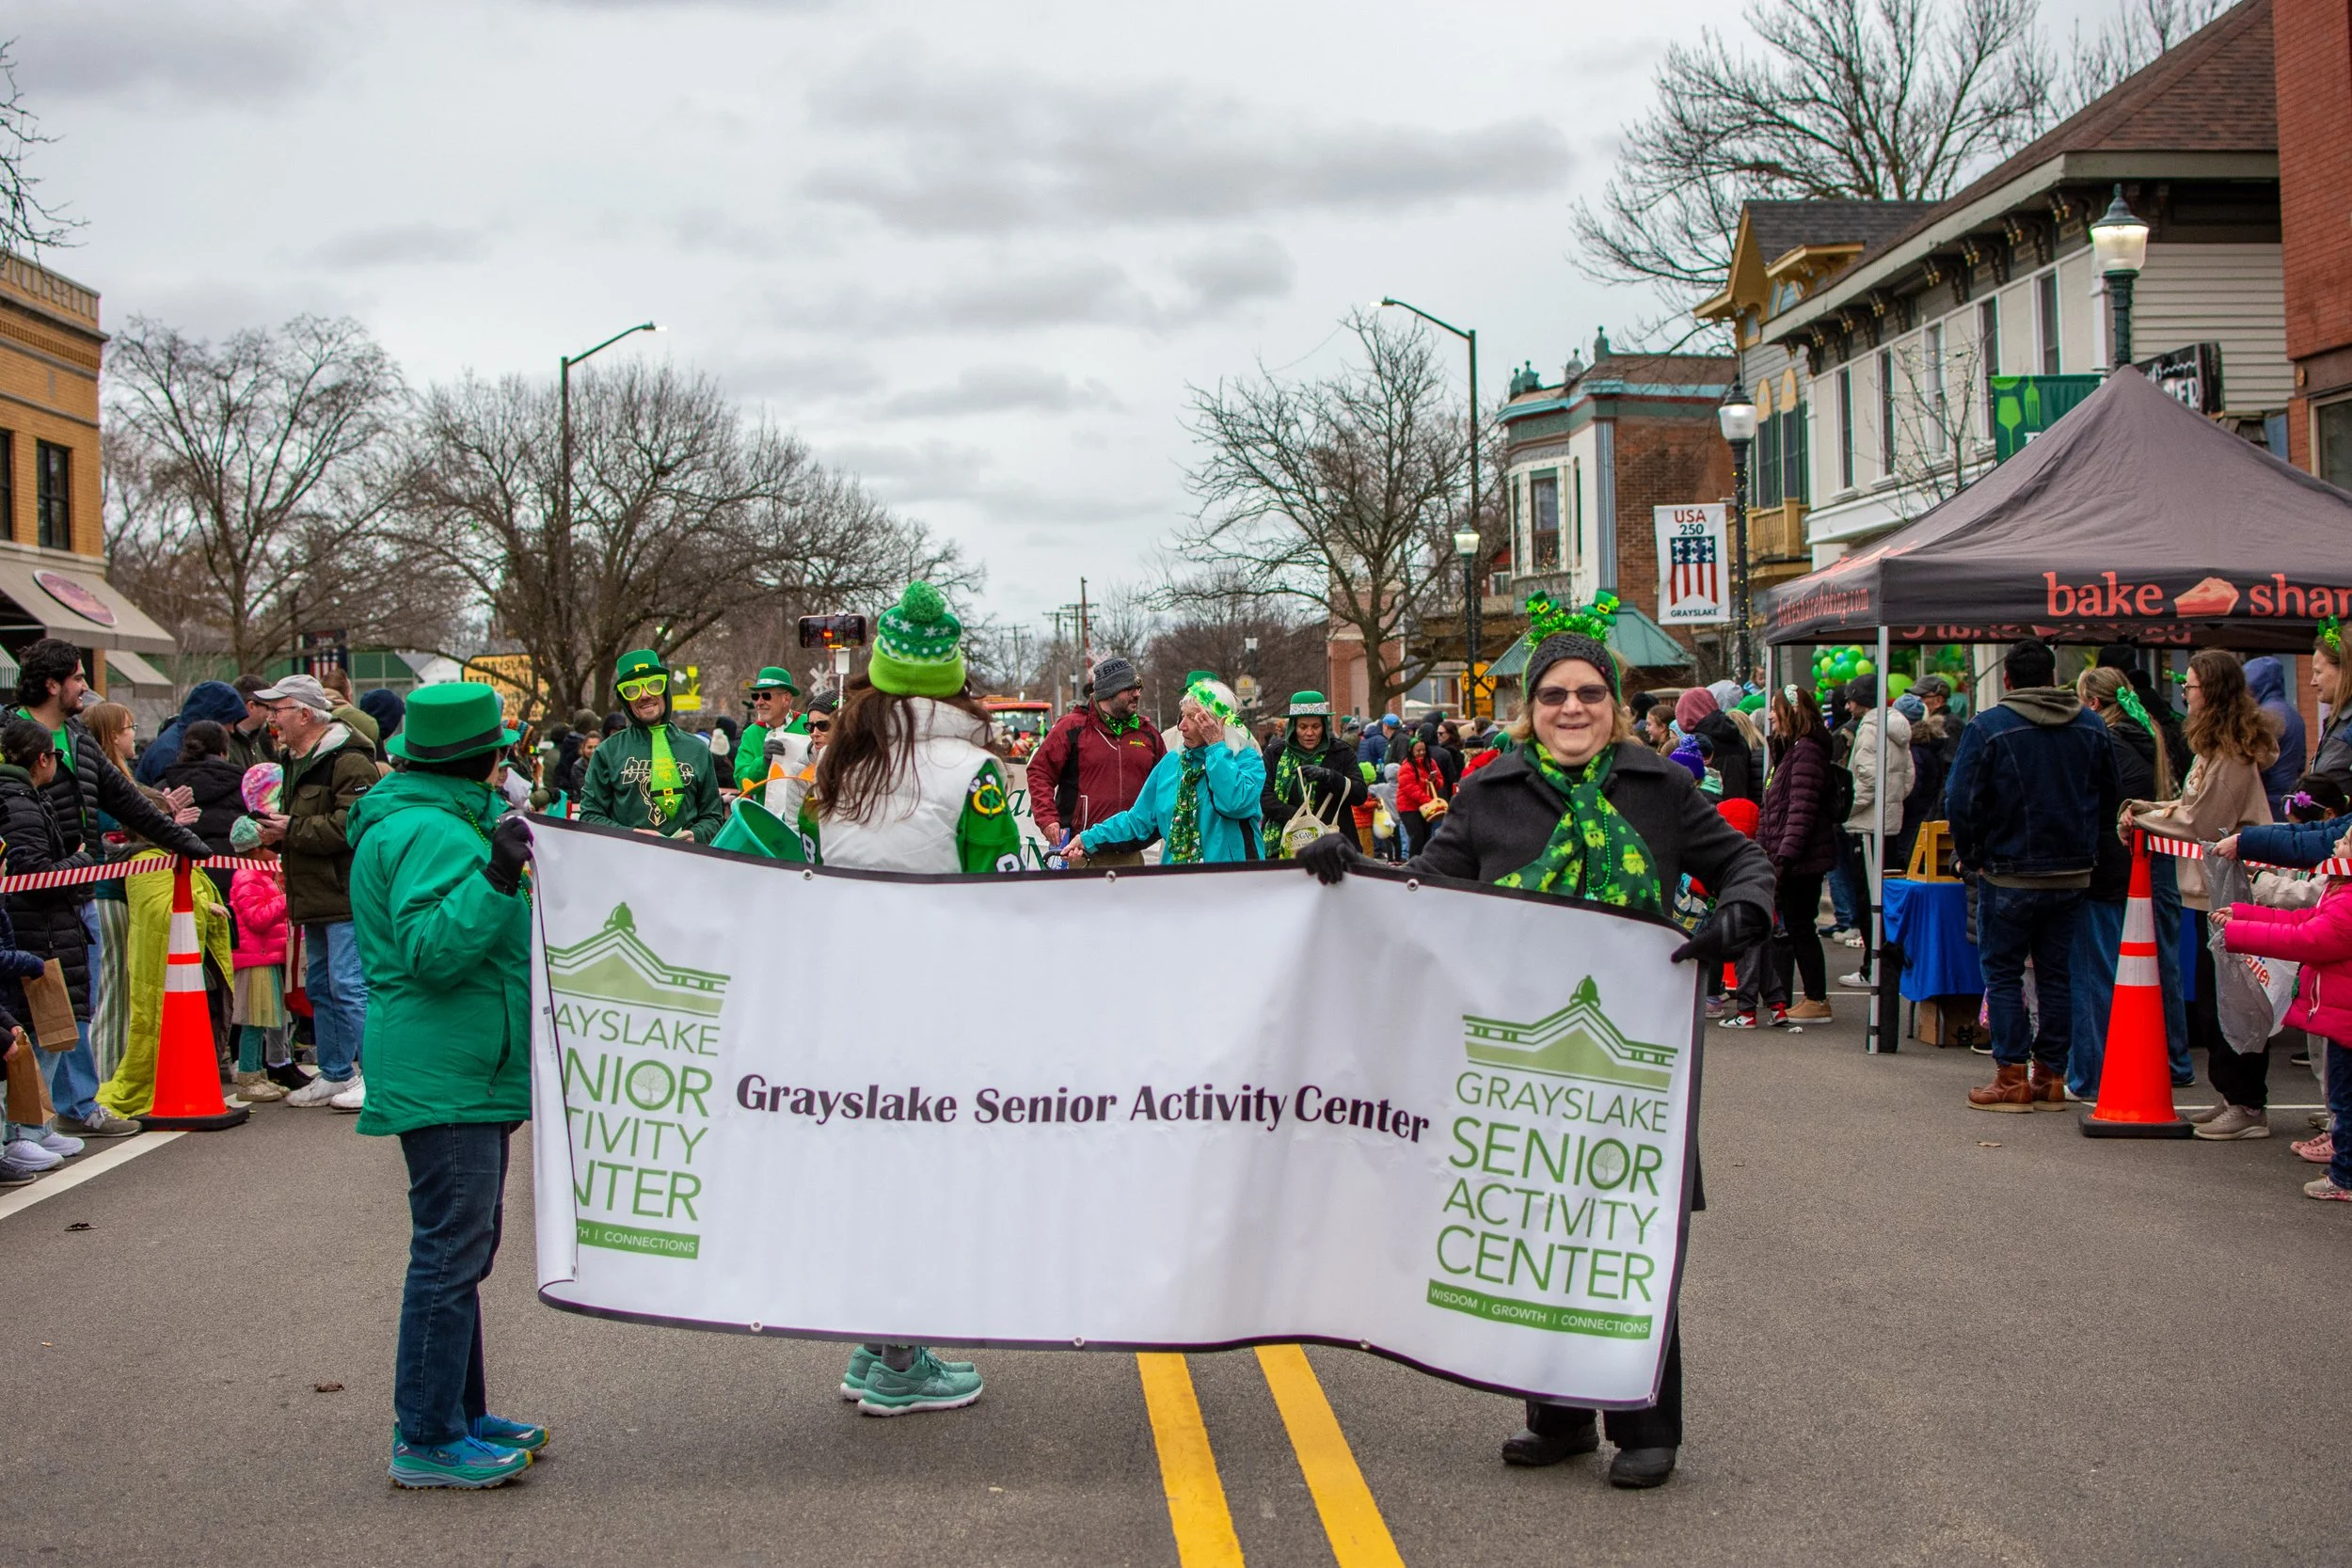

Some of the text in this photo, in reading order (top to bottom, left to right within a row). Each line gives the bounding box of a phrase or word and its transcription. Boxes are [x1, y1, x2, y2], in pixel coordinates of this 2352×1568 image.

[1675, 509, 1707, 523] USA
[1679, 523, 1705, 535] 250
[1670, 608, 1718, 618] GRAYSLAKE
[1777, 581, 1869, 628] bakesharebaking.com
[2042, 571, 2164, 617] bake
[737, 1073, 1430, 1143] Grayslake Senior Activity Center
[1456, 1071, 1669, 1133] GRAYSLAKE
[1449, 1116, 1663, 1196] SENIOR
[1442, 1177, 1660, 1245] ACTIVITY
[604, 1230, 695, 1253] CONNECTIONS
[1437, 1225, 1656, 1303] CENTER
[1430, 1287, 1649, 1334] WISDOM GROWTH CONNECTIONS
